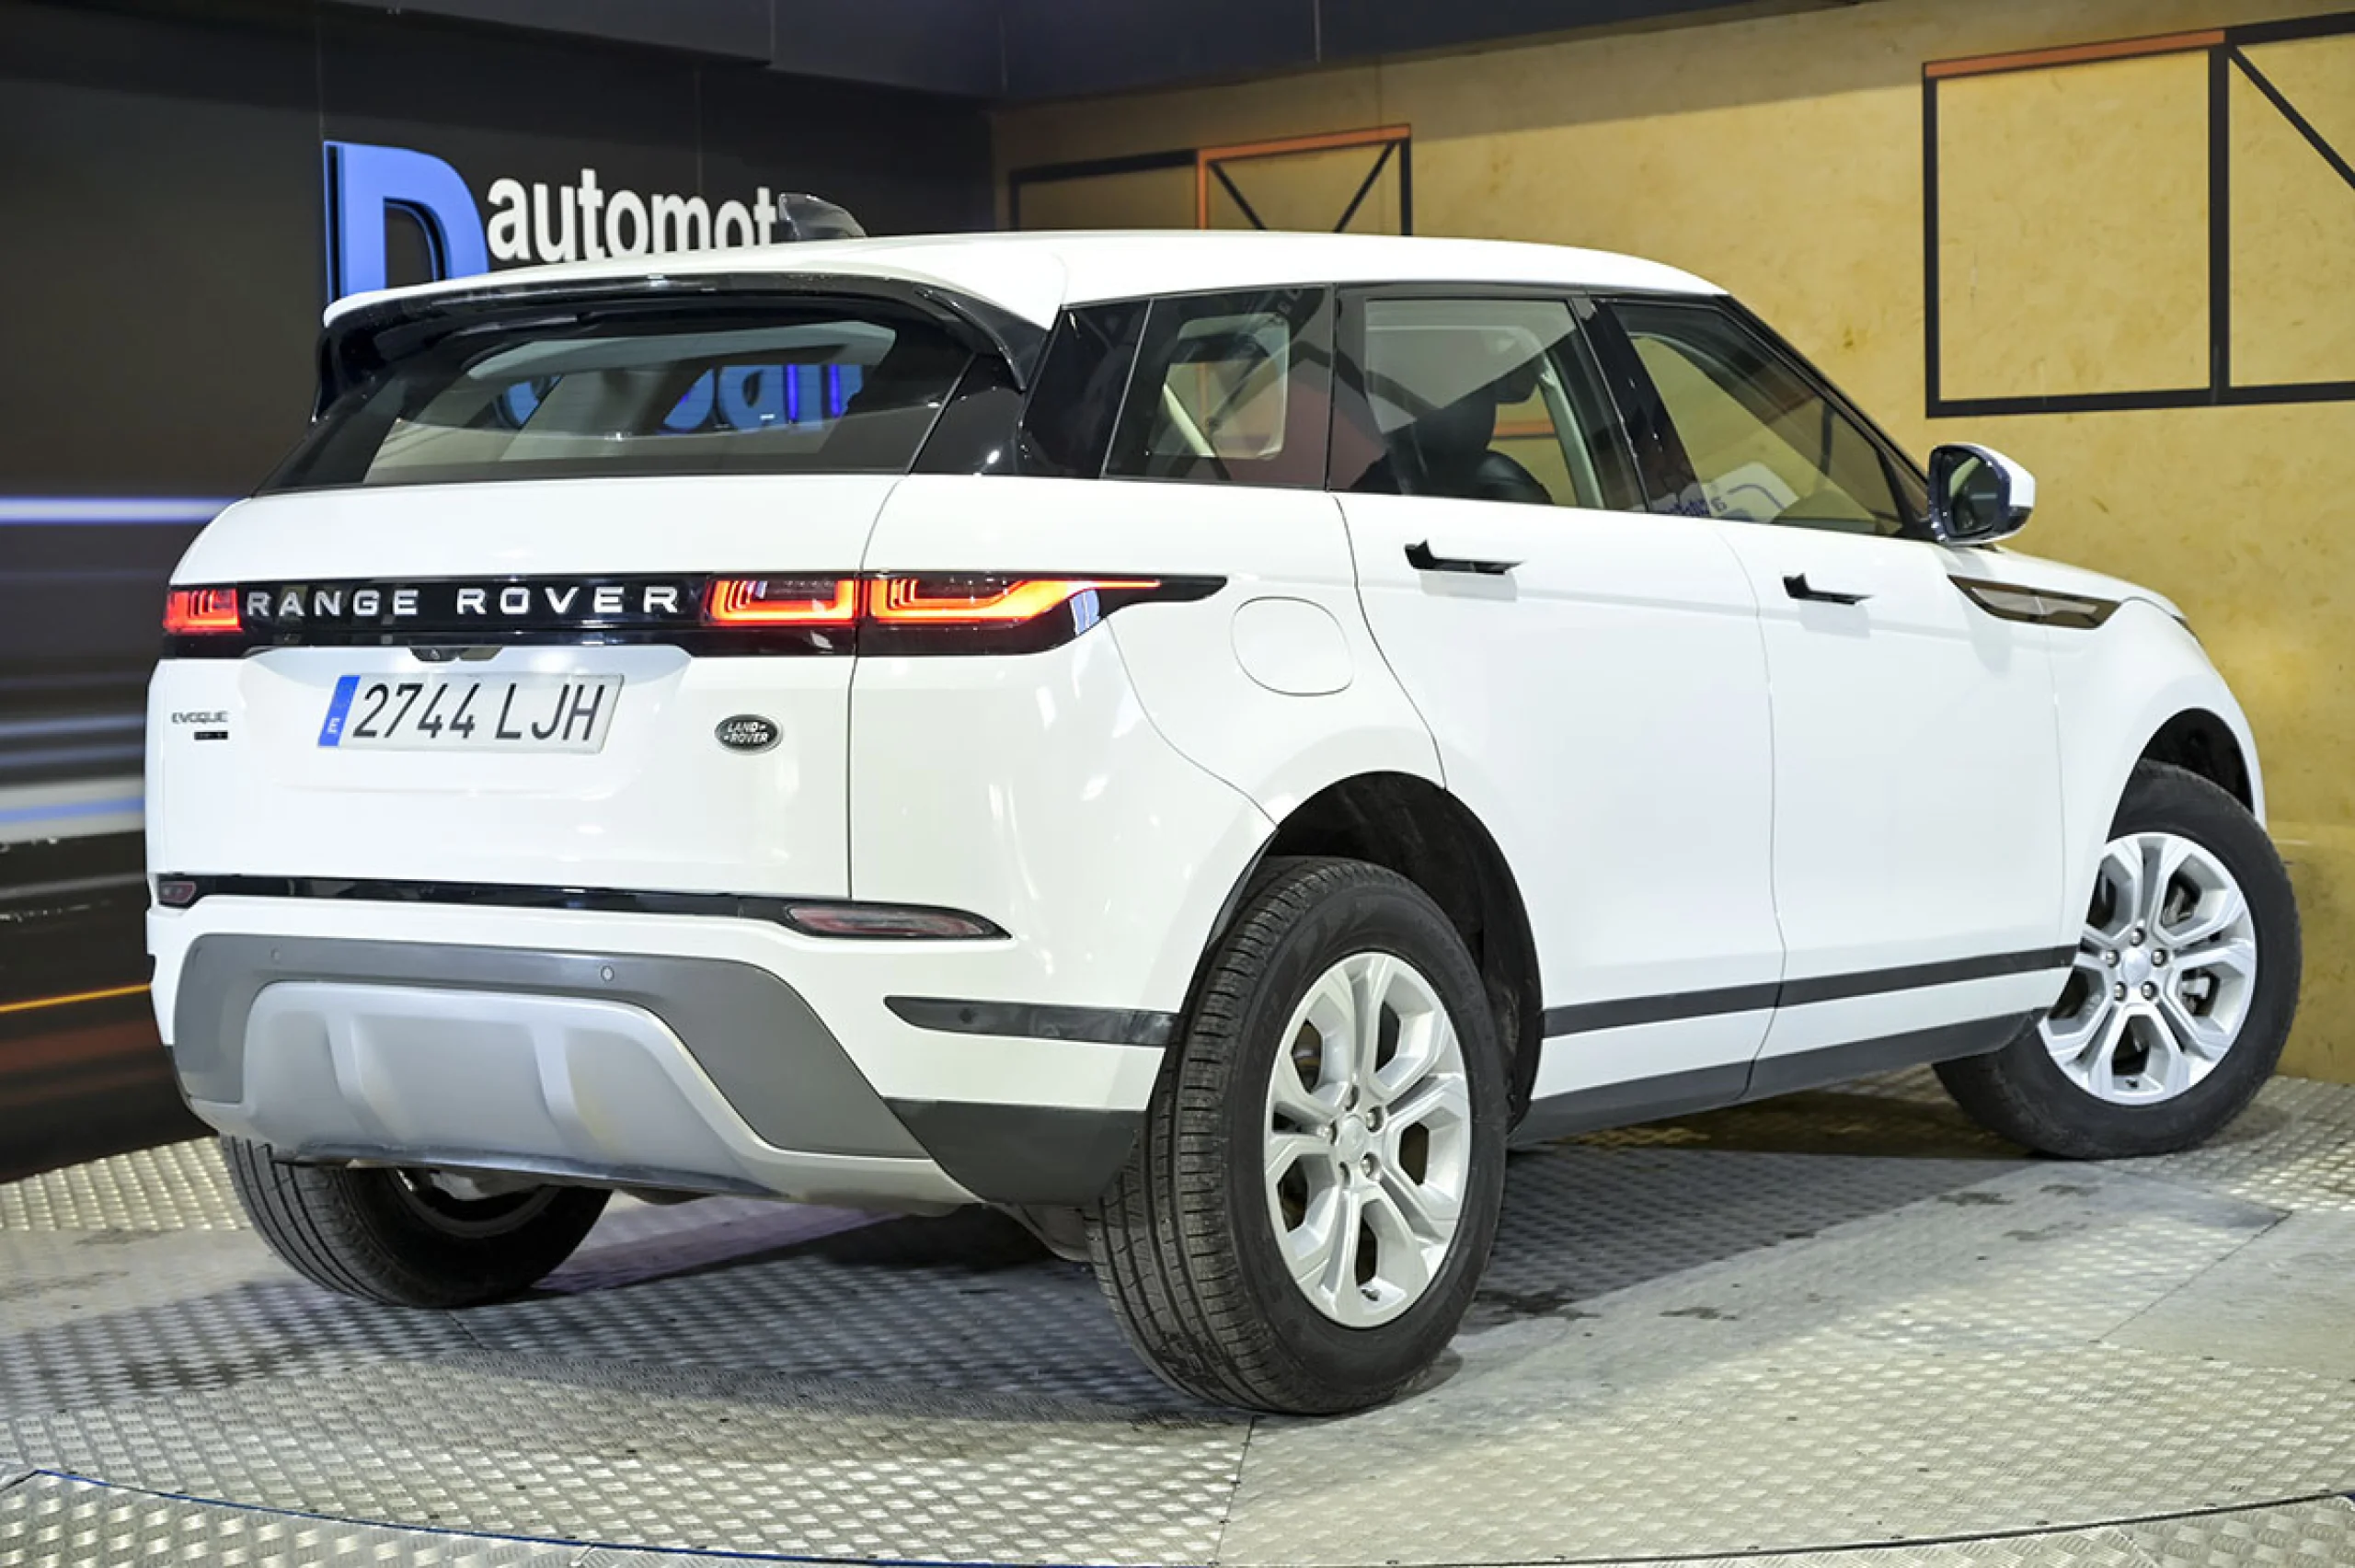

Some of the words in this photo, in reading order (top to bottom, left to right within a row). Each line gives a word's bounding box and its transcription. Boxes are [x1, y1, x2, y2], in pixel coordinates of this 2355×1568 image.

[247, 589, 419, 617] RANGE
[457, 586, 680, 615] ROVER
[171, 710, 229, 724] EVOQUE
[352, 682, 482, 738] 2744
[494, 682, 605, 740] LJH
[327, 717, 340, 734] E
